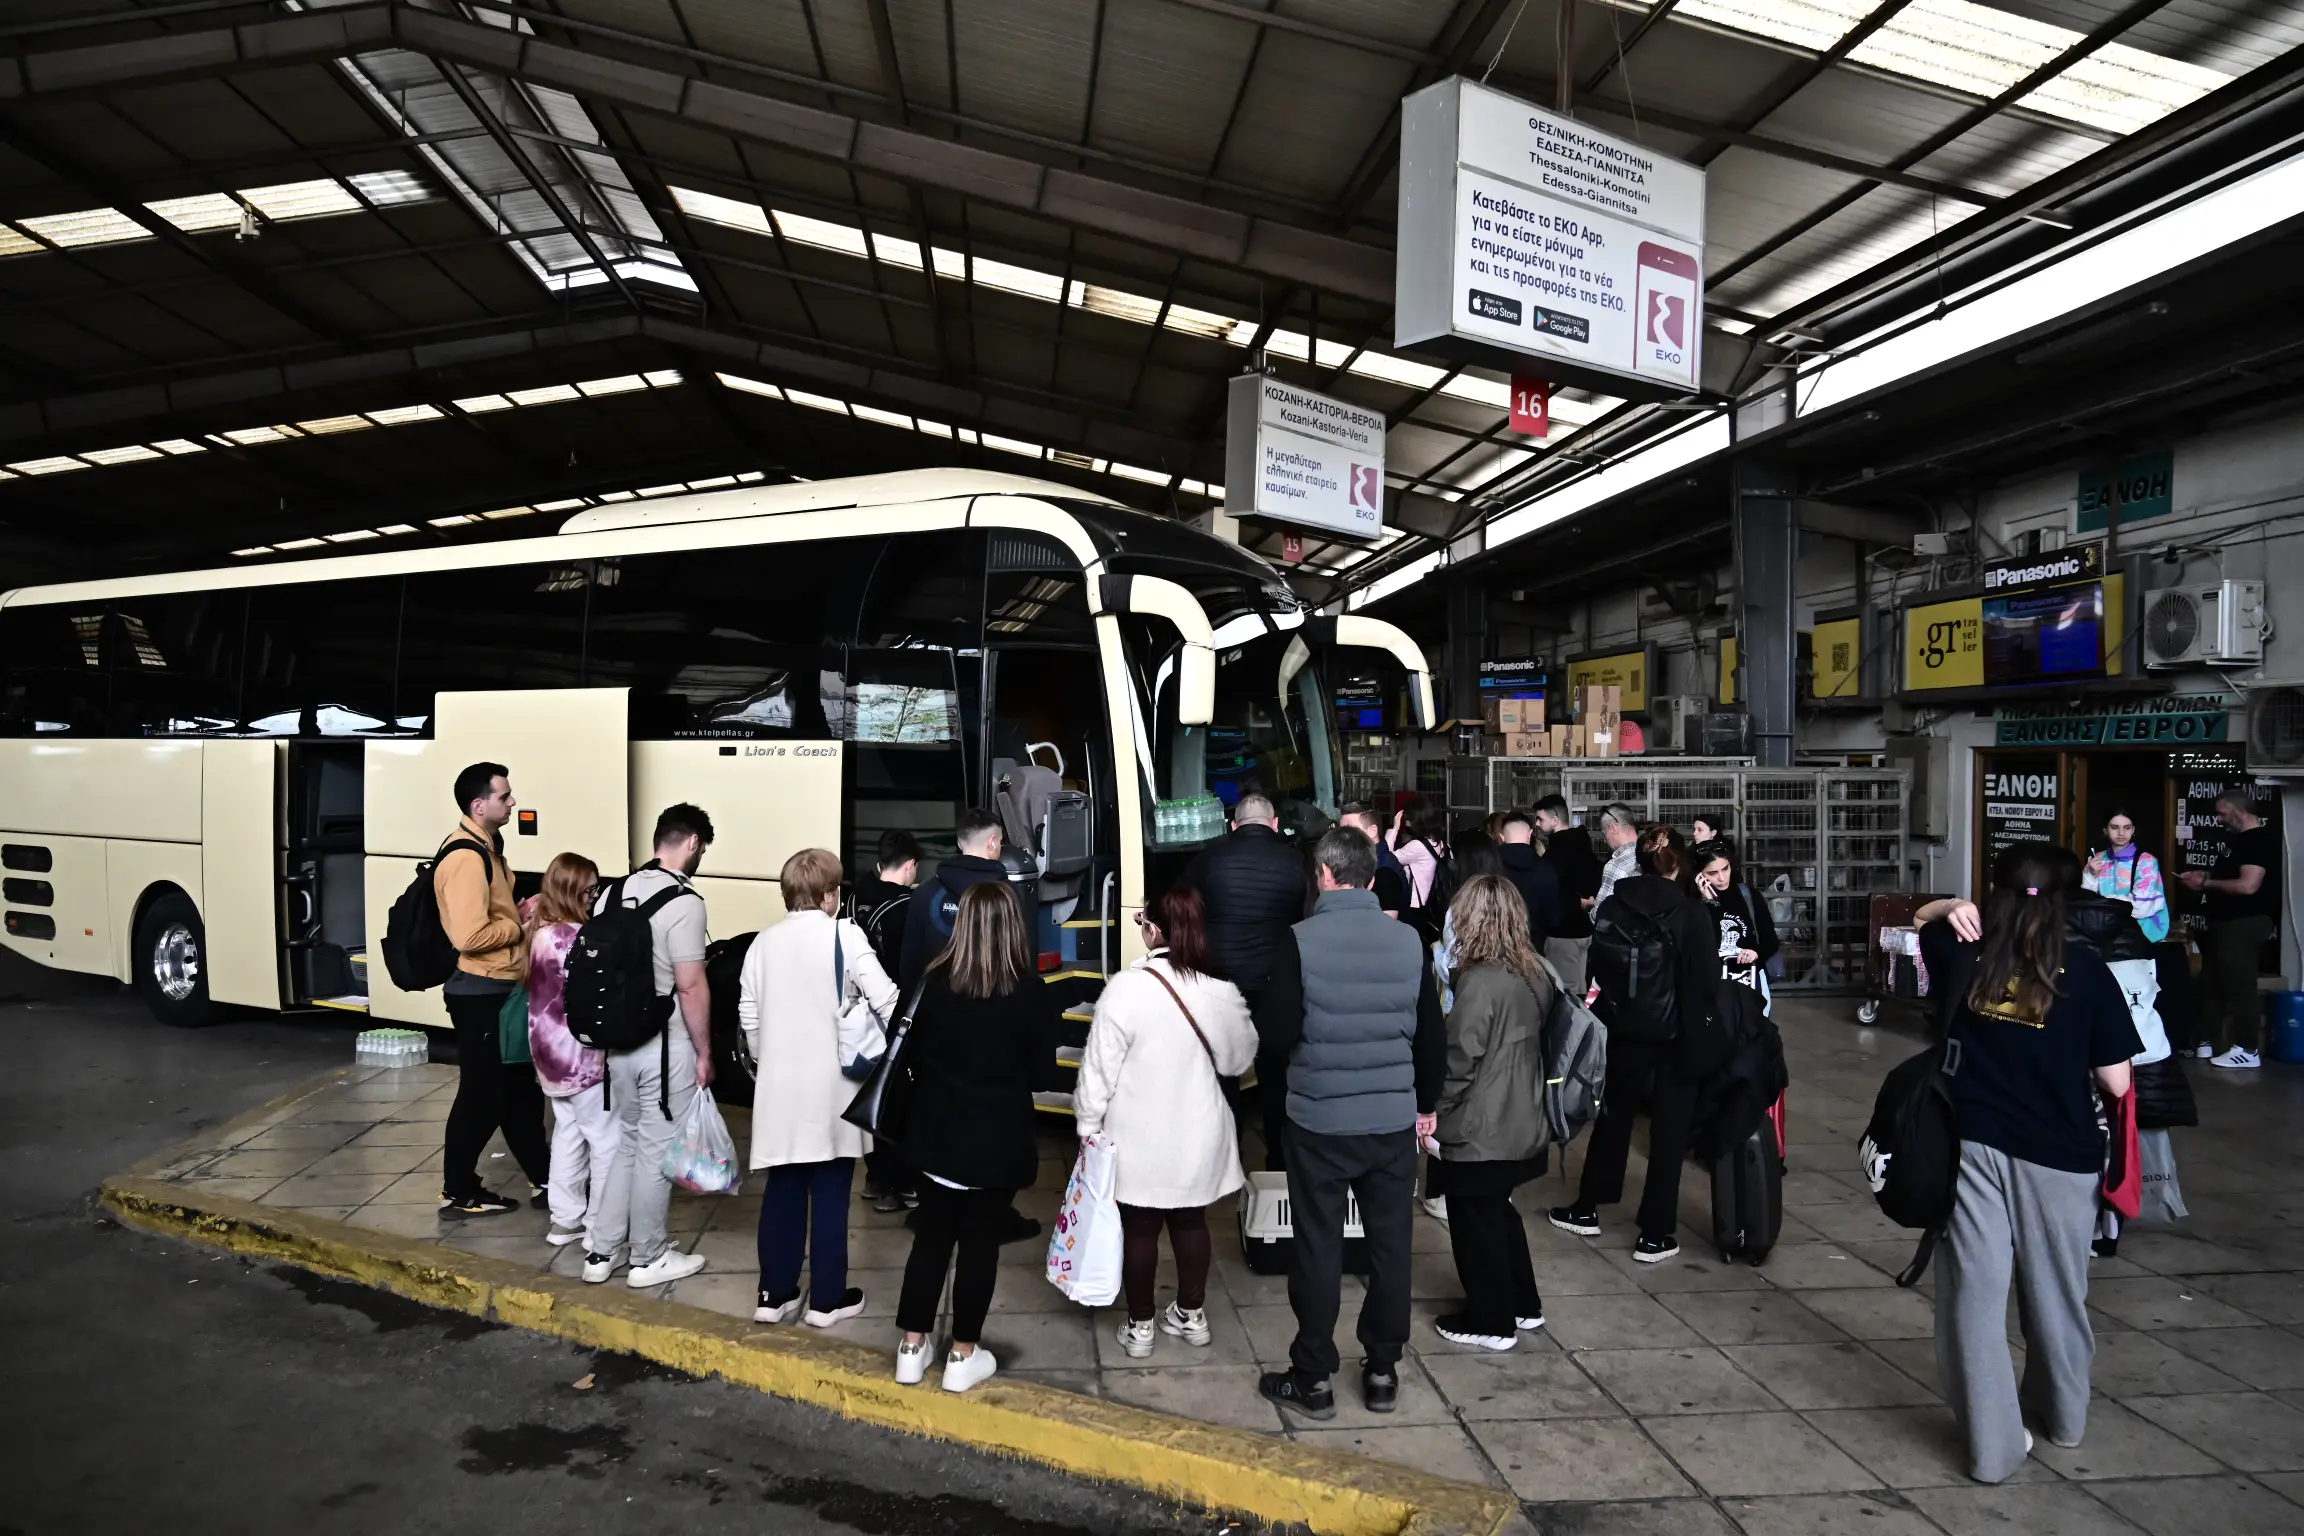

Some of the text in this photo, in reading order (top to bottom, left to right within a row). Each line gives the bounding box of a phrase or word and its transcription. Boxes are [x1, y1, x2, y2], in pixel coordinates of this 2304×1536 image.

[1528, 117, 1653, 173] ΘΕΣ/ΝΙΚΗ-ΚΟΜΟΤΗΝΗ
[1536, 137, 1645, 186] ΕΔΕΣΣΑ-ΓΙΑΝΝΙΤΣΑ
[1529, 151, 1651, 204] Thessaloniki-Komotini
[1542, 173, 1638, 215] Edessa-Giannitsa
[1472, 189, 1535, 225] Κατεβάστε
[1538, 214, 1551, 230] το
[1581, 228, 1605, 249] App.
[1472, 215, 1584, 261] για να είστε μόνιμα
[1471, 238, 1613, 289] ενημερωμένοι για τα νέα
[1470, 258, 1490, 275] και
[1493, 264, 1510, 281] τις
[1512, 269, 1577, 300] προσφορές
[1579, 289, 1597, 305] της
[1484, 303, 1518, 320] App Store
[1550, 320, 1586, 339] Google Play
[1265, 385, 1382, 432] ΚΟΖΑΝΗ-ΚΑΣΤΟΡΙΑ-ΒΕΡΟΙΑ
[1517, 391, 1542, 418] 16
[1280, 408, 1368, 444] Kozani-Kastoria-Veria
[1275, 450, 1322, 471] μεγαλύτερη
[1266, 465, 1337, 491] ελληνική εταιρεία
[1265, 481, 1308, 500] καυσίμων.
[2081, 471, 2168, 512] ΞΑΝΘΗ
[1286, 537, 1299, 553] 15
[1996, 555, 2079, 587] Panasonic
[1962, 628, 1976, 639] vel
[1963, 618, 1977, 627] tra
[1919, 620, 1961, 668] .gr
[1963, 642, 1977, 652] ler
[1487, 659, 1535, 672] Panasonic
[1341, 686, 1375, 695] Panasonic
[673, 729, 755, 738] www.ktelpellas.gr
[2001, 715, 2223, 743] ΞΑΝΘΗΣ ΕΒΡΟΥ
[744, 746, 786, 757] Lion's
[792, 746, 837, 757] Coach
[1984, 773, 2057, 798] ΞΑΝΘΗ
[2187, 781, 2224, 799] ΑΘΗΝΑ
[2004, 807, 2024, 816] ΝΟΜΟΥ
[2025, 807, 2043, 817] ΕΒΡΟΥ
[2004, 820, 2031, 829] ΑΘΗΝΑ
[1994, 831, 2050, 842] ΑΛΕΞΑΝΔΡΟΥΠΟΛΗ
[2186, 839, 2209, 852] 07:15
